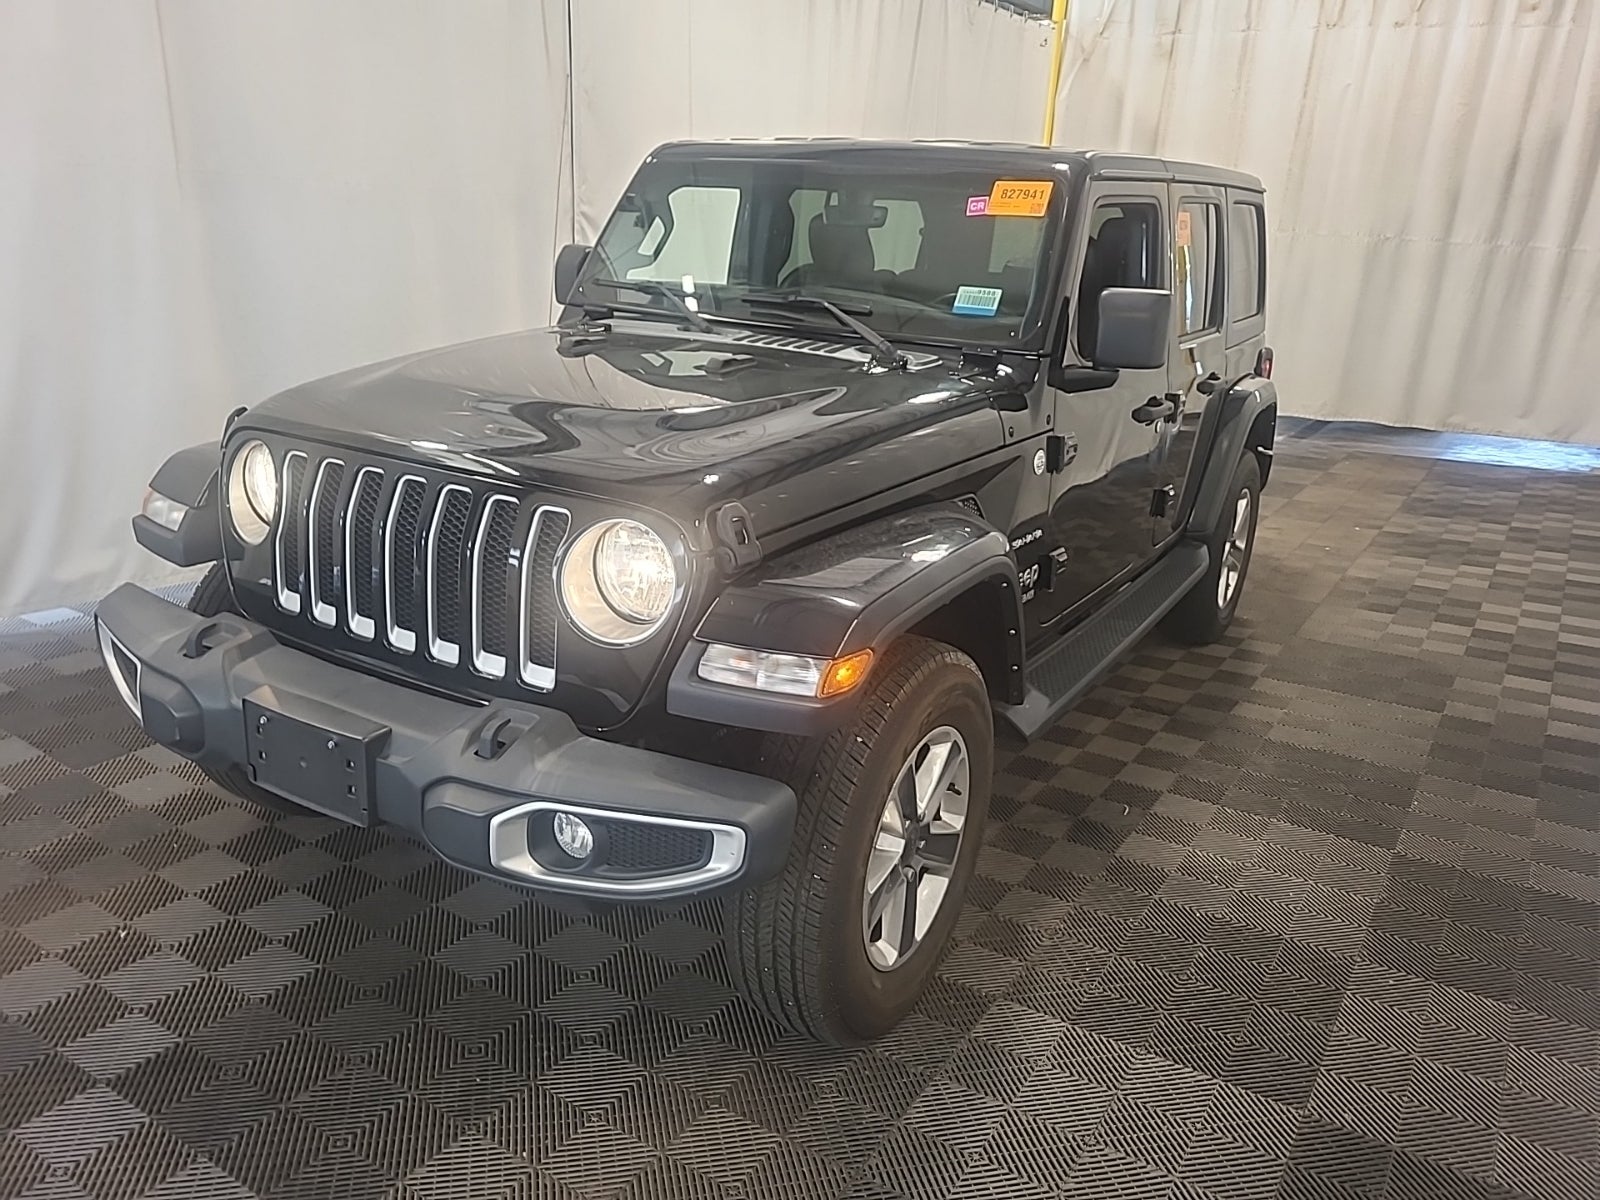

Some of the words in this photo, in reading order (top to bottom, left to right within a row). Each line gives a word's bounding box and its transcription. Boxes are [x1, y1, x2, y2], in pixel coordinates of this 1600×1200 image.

[1000, 188, 1046, 200] 827941
[970, 201, 985, 211] CR
[1018, 564, 1039, 588] eep
